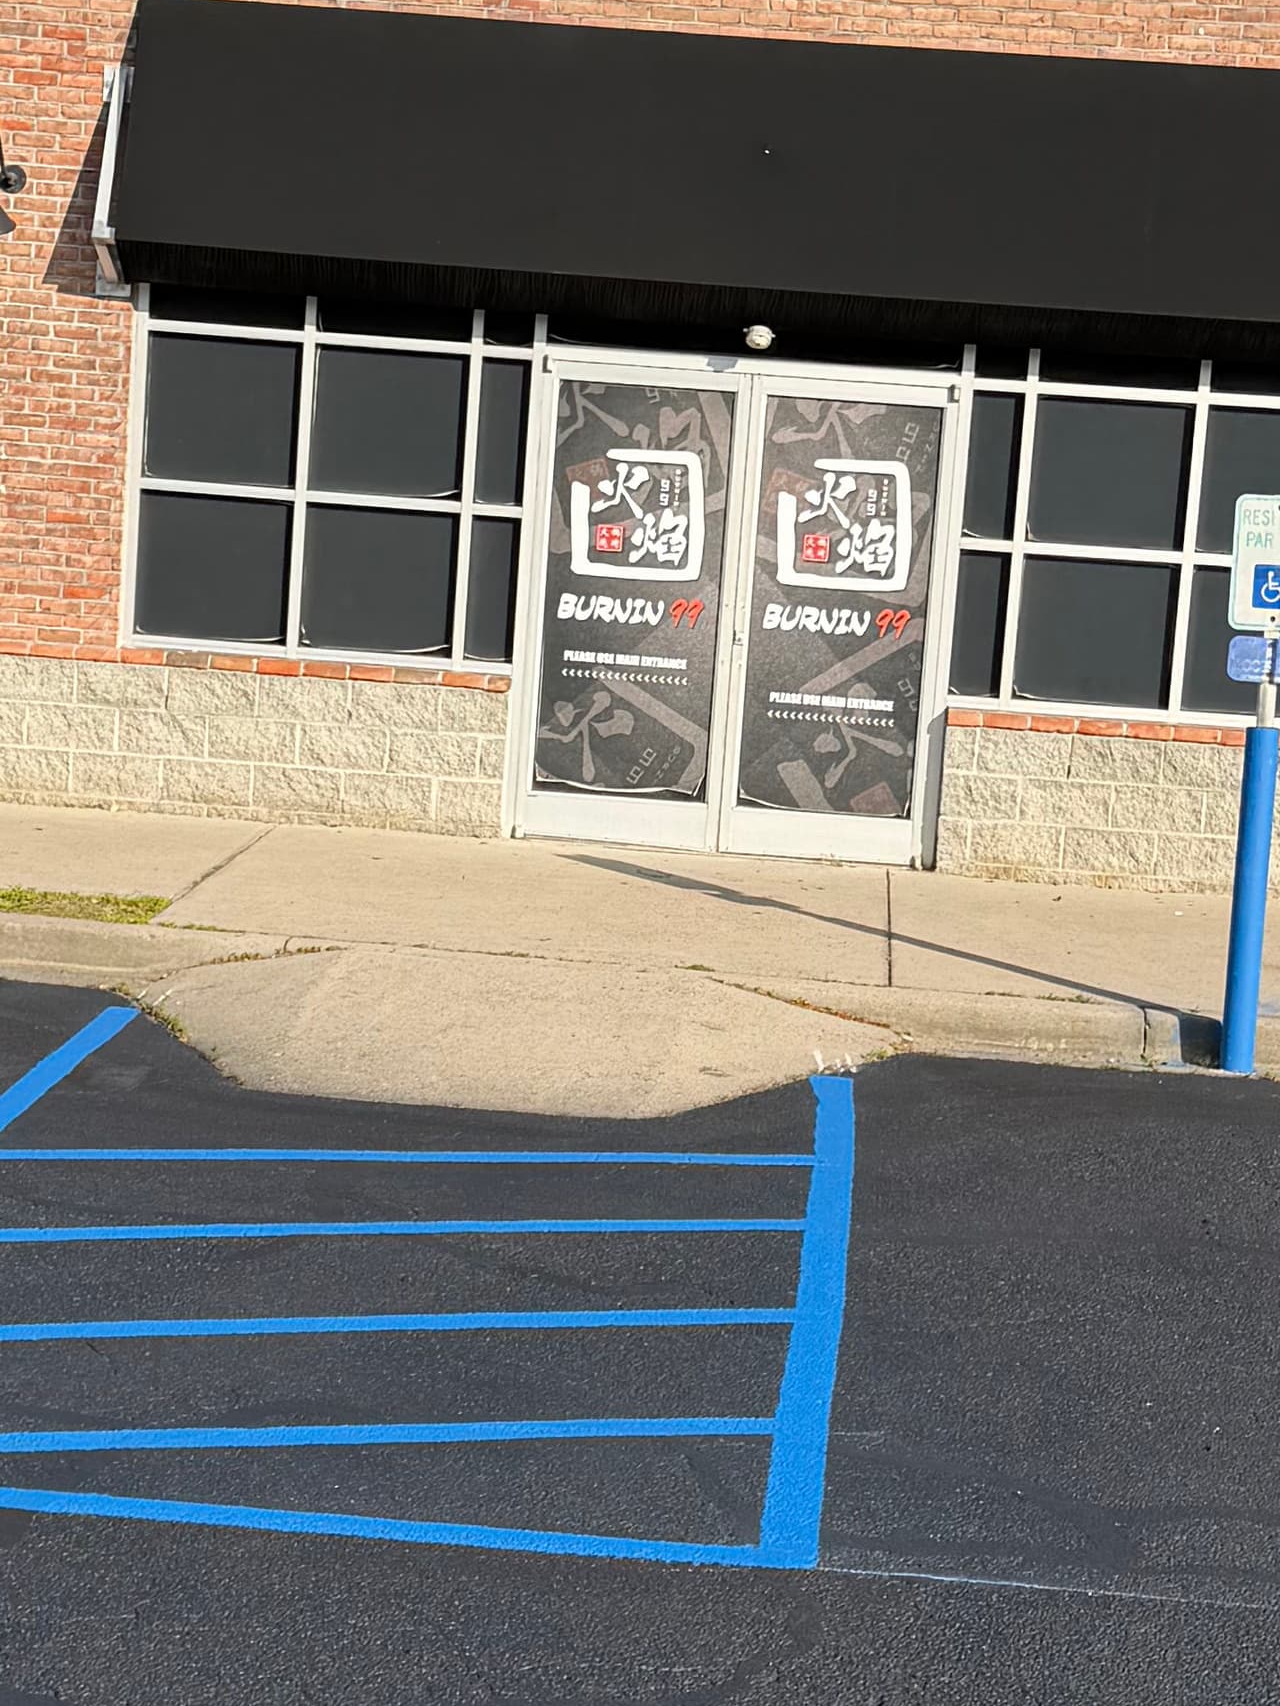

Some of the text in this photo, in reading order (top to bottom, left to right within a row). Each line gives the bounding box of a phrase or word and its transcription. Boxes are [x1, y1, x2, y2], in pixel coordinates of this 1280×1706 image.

[557, 593, 704, 629] BURNIN 99
[762, 603, 911, 640] BURNIN 99
[563, 649, 687, 670] PLEASE USE MAIN ENTRANCE
[769, 691, 894, 712] PLEASE USE MAIN ENTRANCE
